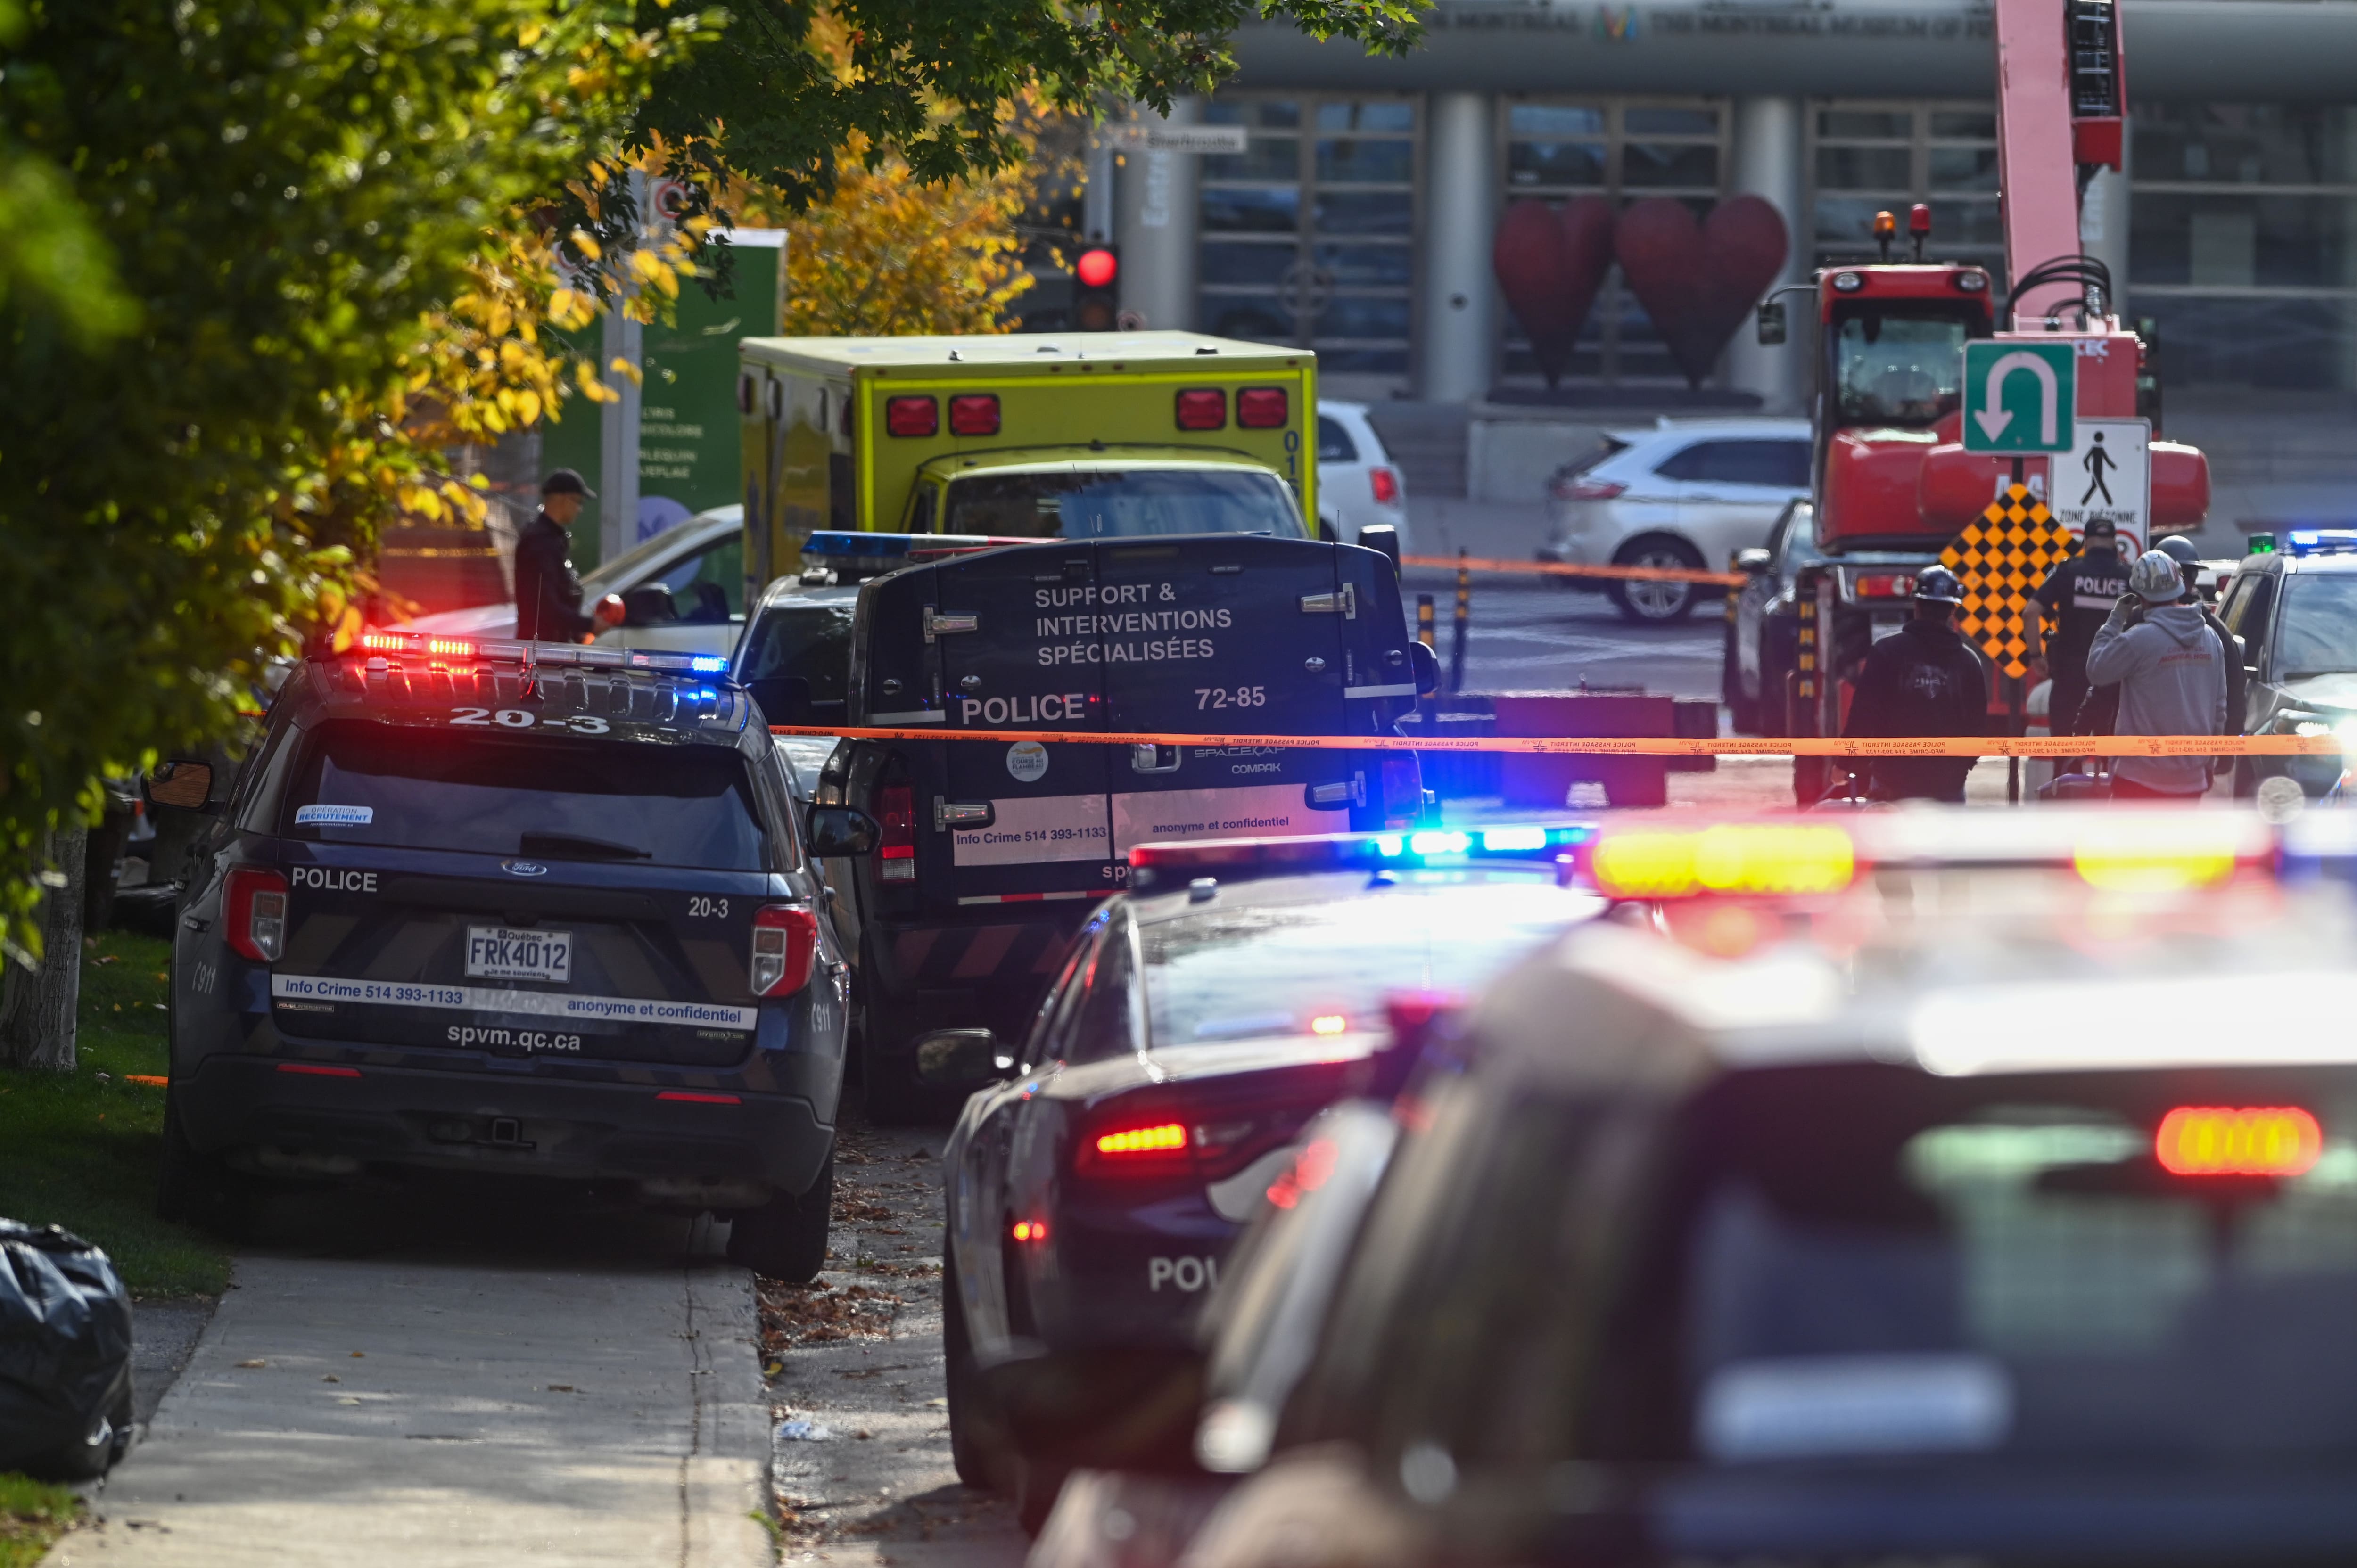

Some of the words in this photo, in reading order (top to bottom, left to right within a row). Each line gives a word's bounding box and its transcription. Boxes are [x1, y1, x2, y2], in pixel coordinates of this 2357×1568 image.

[1036, 584, 1151, 607] SUPPORT
[1159, 583, 1176, 601] &
[2074, 575, 2127, 596] POLICE
[1037, 609, 1232, 636] INTERVENTIONS
[1038, 636, 1214, 665] SPÉCIALISÉES
[963, 693, 1085, 724] POLICE
[1195, 686, 1266, 709] 72-85
[450, 707, 610, 734] 20-3
[1232, 763, 1281, 773] COMPAK
[312, 806, 357, 814] OPÉRATION
[956, 833, 980, 846] Info
[983, 831, 1022, 844] Crime
[1025, 830, 1047, 841] 514
[1050, 827, 1107, 841] 393-1133
[1153, 822, 1204, 835] anonyme
[1209, 821, 1219, 830] et
[1223, 817, 1289, 829] confidentiel
[512, 862, 536, 873] Ford
[292, 867, 377, 892] POLICE
[689, 896, 728, 918] 20-3
[508, 932, 542, 942] Québec
[471, 938, 567, 970] FRK4012
[513, 969, 545, 977] souviens
[286, 979, 312, 993] Info
[317, 982, 361, 997] Crime
[365, 985, 391, 998] 514
[396, 987, 463, 1004] 393-1133
[568, 999, 635, 1016] anonyme
[640, 1003, 653, 1015] et
[657, 1006, 741, 1022] confidentiel
[447, 1026, 581, 1051] spvm.qc.ca
